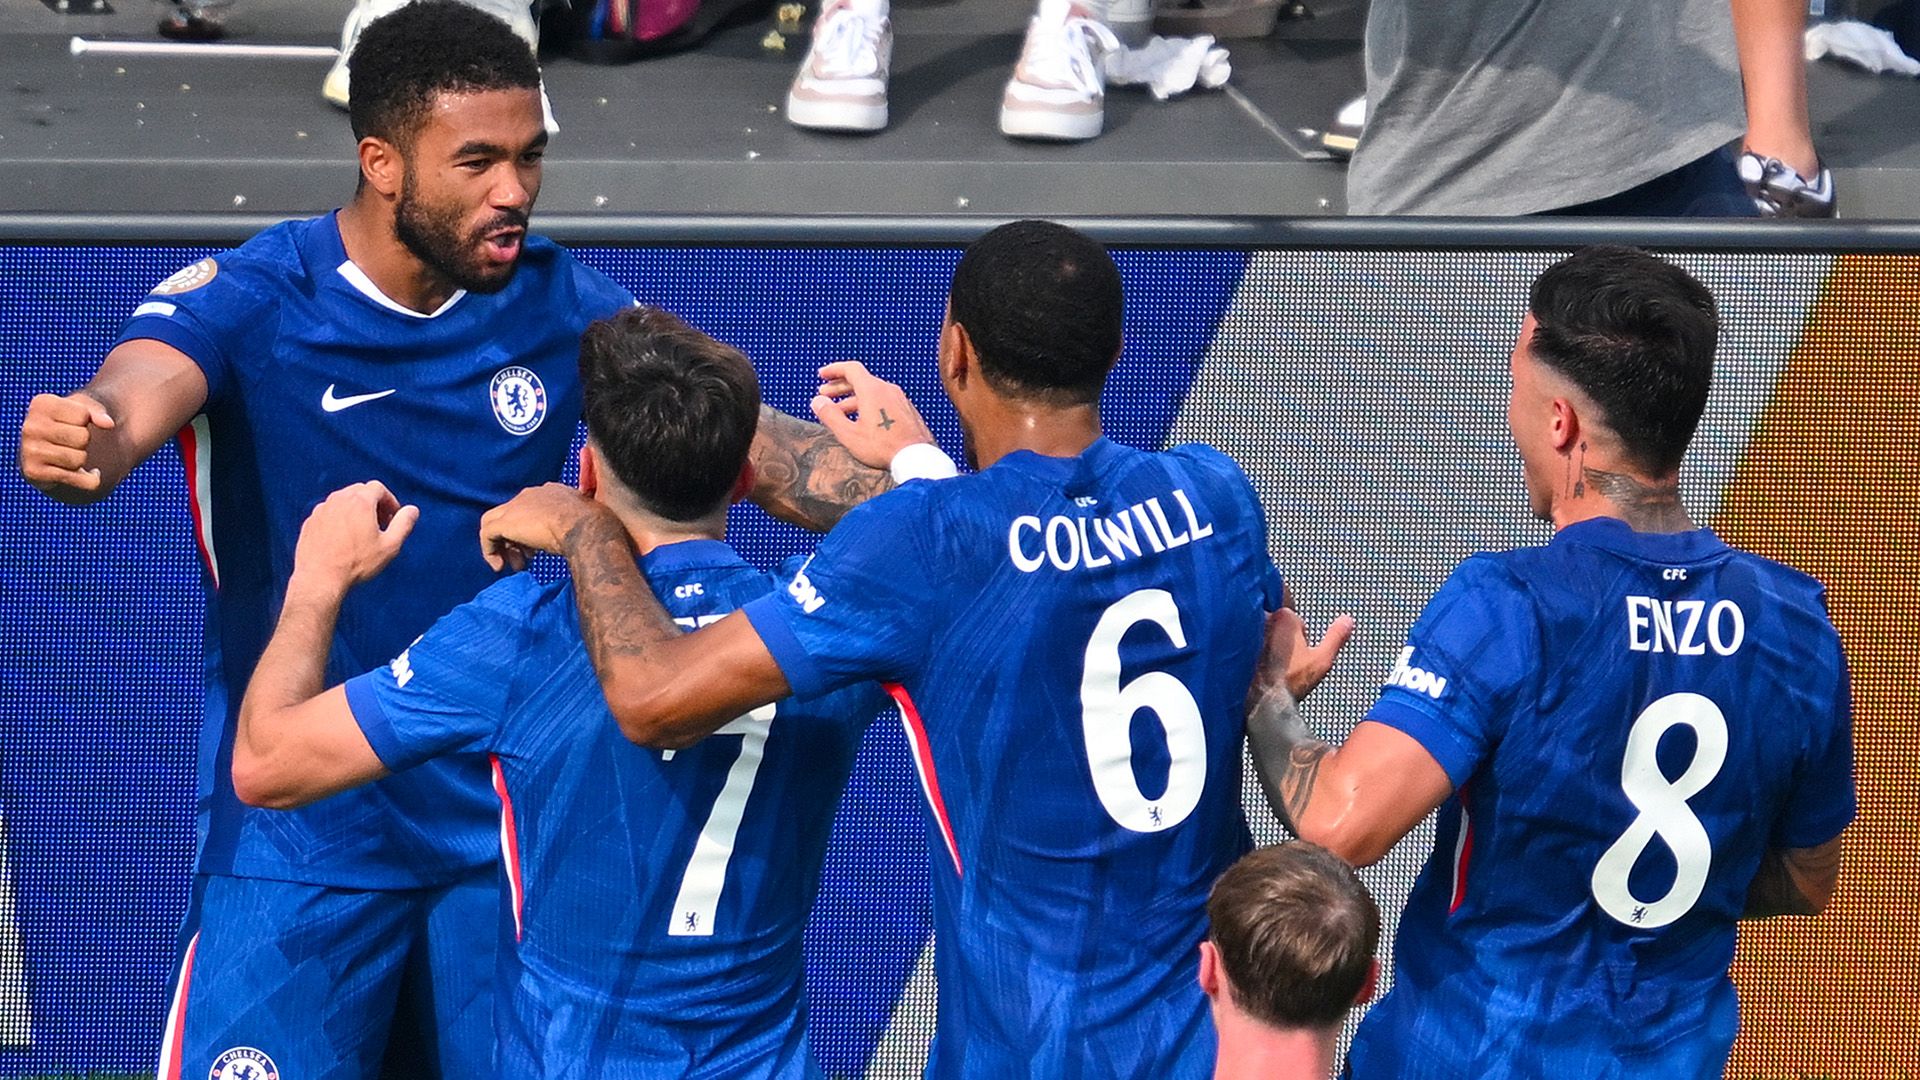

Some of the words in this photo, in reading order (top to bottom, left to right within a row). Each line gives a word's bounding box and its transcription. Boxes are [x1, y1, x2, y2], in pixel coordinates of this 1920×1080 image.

[495, 369, 533, 385] CHELSEA
[1008, 488, 1214, 573] COLWILL
[674, 583, 704, 599] CFC
[1662, 568, 1687, 580] CFC
[1626, 595, 1745, 656] ENZO
[1080, 588, 1208, 833] 6
[662, 702, 777, 936] 7
[1591, 692, 1729, 928] 8
[222, 1050, 267, 1066] CHELSEA
